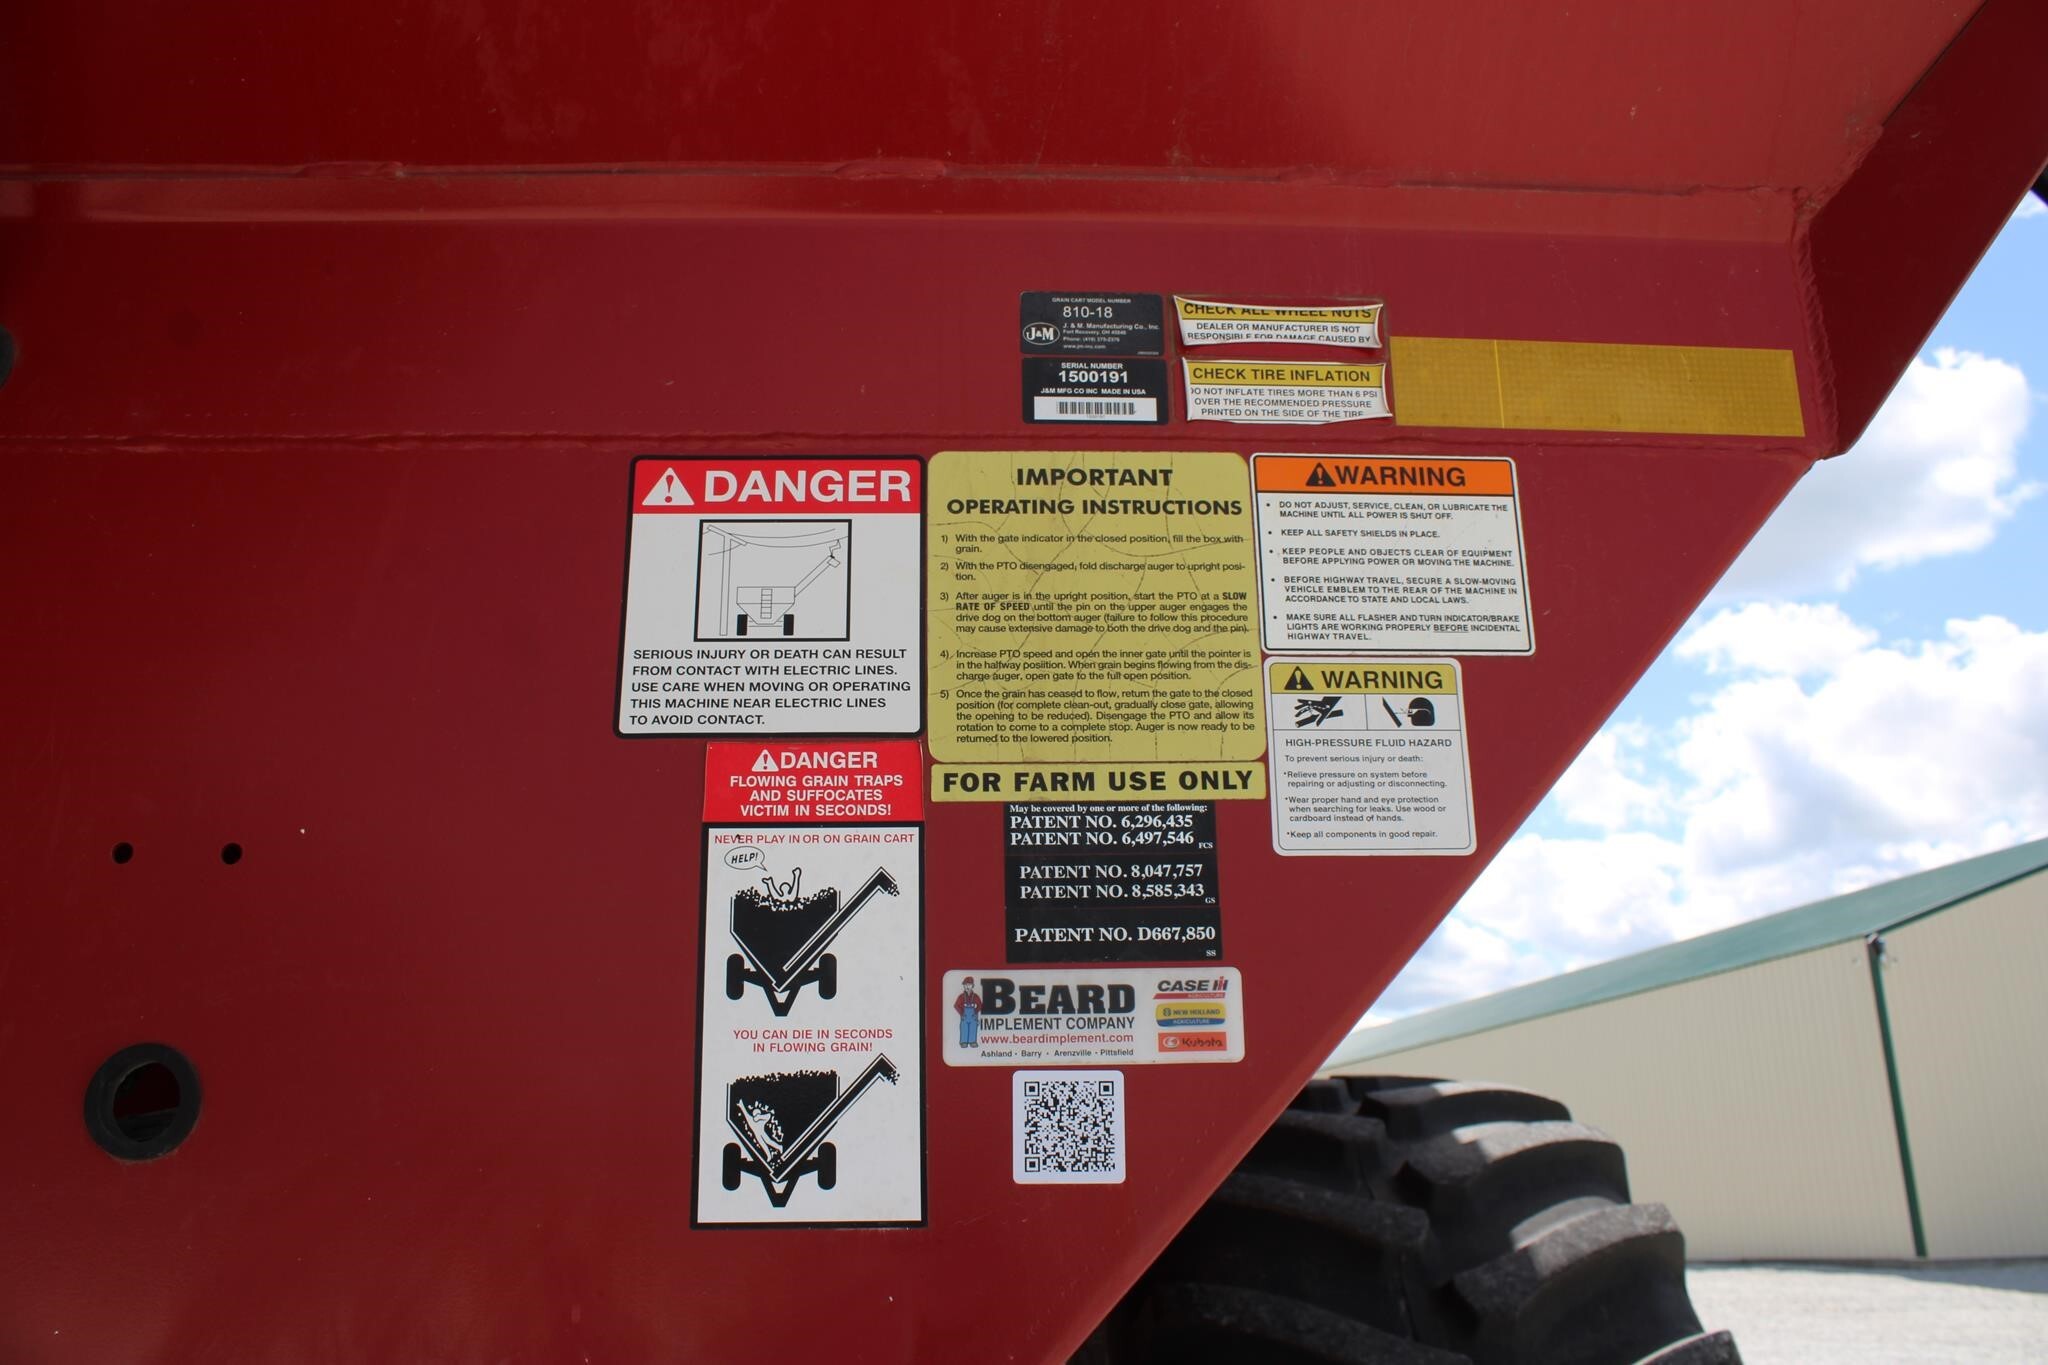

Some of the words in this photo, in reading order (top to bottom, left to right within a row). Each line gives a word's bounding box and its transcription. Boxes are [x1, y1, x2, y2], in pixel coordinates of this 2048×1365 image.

[1062, 305, 1112, 318] 810-18
[1184, 303, 1236, 315] CHECK
[1026, 326, 1054, 341] J&M
[1196, 322, 1233, 330] DEALER
[1251, 323, 1328, 332] MANUFACTURER
[1341, 325, 1360, 333] NOT
[1058, 370, 1127, 383] 1500191
[1192, 367, 1246, 379] CHECK
[1250, 368, 1286, 380] TIRE
[1290, 369, 1370, 381] INFLATION
[1194, 397, 1220, 405] OVER
[1222, 398, 1241, 406] THE
[1243, 398, 1320, 407] RECOMMENDED
[1321, 399, 1371, 408] PRESSURE
[1016, 468, 1173, 486] IMPORTANT
[1335, 465, 1466, 486] WARNING
[704, 469, 911, 502] DANGER
[946, 499, 1075, 514] OPERATING
[1082, 499, 1242, 515] INSTRUCTIONS
[1280, 528, 1304, 536] KEEP
[1359, 529, 1397, 537] SHIELDS
[1409, 530, 1440, 538] PLACE.
[633, 649, 693, 659] SERIOUS
[696, 649, 746, 659] INJURY
[749, 649, 770, 659] OR
[773, 649, 818, 659] DEATH
[822, 648, 851, 659] CAN
[855, 648, 907, 658] RESULT
[632, 665, 672, 675] FROM
[675, 665, 741, 675] CONTACT
[744, 665, 779, 675] WITH
[783, 665, 850, 675] ELECTRIC
[854, 665, 897, 675] LINES.
[1320, 670, 1442, 689] WARNING
[631, 681, 658, 692] USE
[662, 682, 699, 692] CARE
[703, 681, 744, 692] WHEN
[749, 681, 804, 691] MOVING
[808, 681, 828, 691] OR
[832, 681, 910, 691] OPERATING
[630, 698, 661, 708] THIS
[664, 698, 729, 708] MACHINE
[733, 698, 770, 708] NEAR
[774, 697, 842, 708] ELECTRIC
[846, 697, 886, 707] LINES
[628, 714, 647, 725] TO
[651, 714, 693, 724] AVOID
[697, 714, 764, 724] CONTACT.
[956, 733, 999, 744] returned
[999, 734, 1010, 742] to
[1011, 733, 1028, 742] the
[1029, 733, 1069, 742] lowered
[1071, 732, 1112, 745] position.
[1285, 738, 1372, 747] HIGH-PRESSURE
[1375, 738, 1406, 747] FLUID
[1408, 738, 1452, 747] HAZARD
[780, 751, 877, 768] DANGER
[1284, 754, 1295, 762] To
[1296, 755, 1328, 763] prevent
[1361, 754, 1385, 763] injury
[1397, 754, 1423, 762] death:
[730, 775, 796, 787] FLOWING
[802, 775, 848, 787] GRAIN
[853, 774, 903, 786] TRAPS
[943, 772, 1001, 792] FOR
[1014, 771, 1095, 791] FARM
[1108, 770, 1166, 791] USE
[1178, 770, 1252, 790] ONLY
[749, 789, 781, 801] AND
[786, 788, 882, 801] SUFFOCATES
[740, 804, 789, 816] VICTIM
[795, 804, 809, 816] IN
[815, 803, 891, 816] SECONDS!
[1009, 804, 1028, 814] May
[1030, 804, 1041, 812] be
[1042, 804, 1075, 812] covered
[1077, 804, 1087, 813] by
[1140, 803, 1150, 811] of
[1151, 803, 1165, 811] the
[1166, 803, 1207, 812] following:
[1010, 815, 1081, 828] PATENT
[1084, 814, 1117, 828] NO.
[1121, 814, 1193, 830] 6,296,435
[714, 833, 753, 844] NEVER
[756, 834, 785, 843] PLAY
[788, 834, 800, 843] IN
[802, 834, 819, 843] OR
[822, 834, 840, 843] ON
[843, 833, 880, 843] GRAIN
[883, 833, 914, 843] CART
[1010, 831, 1081, 845] PATENT
[1085, 831, 1117, 845] NO.
[1121, 831, 1194, 846] 6,497,546
[1313, 830, 1323, 838] all
[1325, 831, 1377, 839] components
[1388, 830, 1410, 839] good
[731, 852, 758, 864] HELP!
[1020, 865, 1090, 878] PATENT
[1094, 864, 1127, 878] NO.
[1130, 863, 1202, 879] 8,047,757
[1020, 885, 1091, 898] PATENT
[1095, 884, 1128, 898] NO.
[1131, 883, 1204, 898] 8,585,343
[1014, 927, 1094, 942] PATENT
[1098, 926, 1132, 941] NO.
[1137, 926, 1215, 942] D667,850
[1156, 979, 1211, 994] CASE
[979, 978, 1135, 1015] BEARD
[979, 1017, 1062, 1030] IMPLEMENT
[1065, 1016, 1134, 1029] COMPANY
[732, 1029, 758, 1039] YOU
[762, 1029, 788, 1039] CAN
[792, 1029, 812, 1039] DIE
[817, 1029, 829, 1039] IN
[834, 1028, 892, 1039] SECONDS
[980, 1033, 1133, 1045] www.beardimplement.com
[753, 1042, 765, 1052] IN
[769, 1042, 825, 1052] FLOWING
[830, 1042, 872, 1052] GRAIN!
[1181, 1037, 1223, 1047] Kubota
[1020, 1049, 1042, 1058] Barry
[1100, 1048, 1133, 1056] Pittsfield
